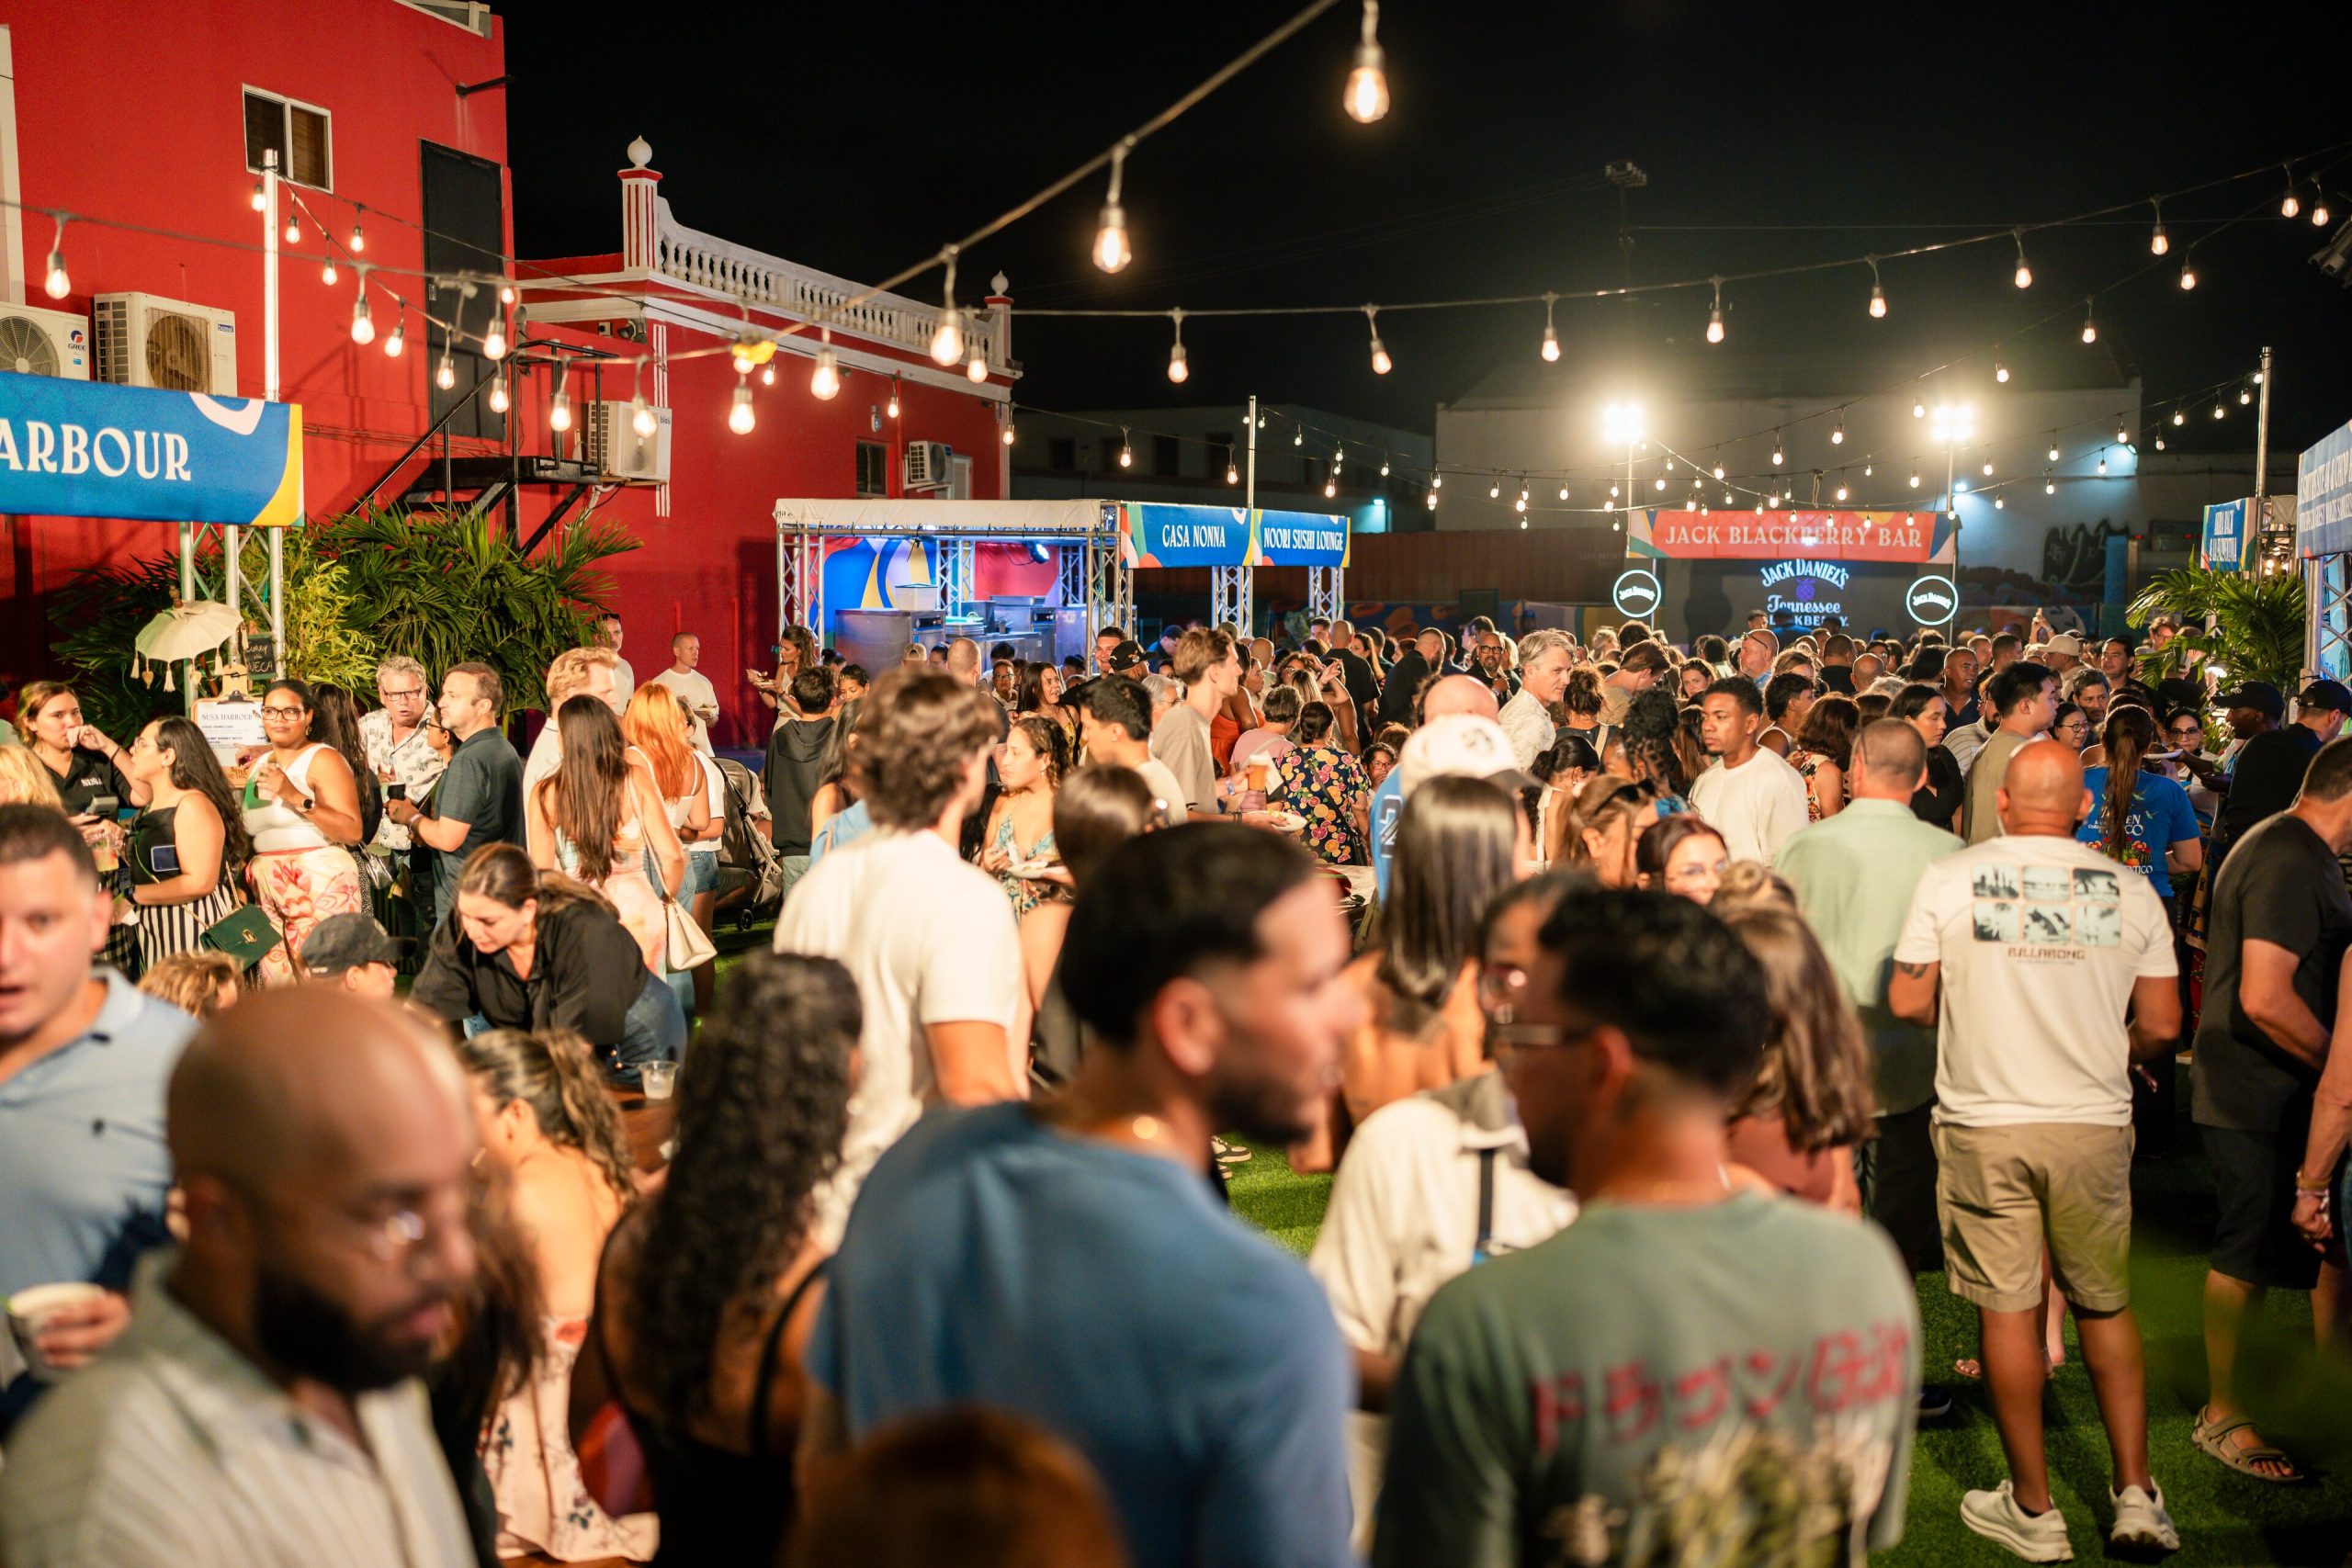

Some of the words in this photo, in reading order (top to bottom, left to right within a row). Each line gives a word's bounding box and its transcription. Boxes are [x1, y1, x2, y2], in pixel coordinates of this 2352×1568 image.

[0, 418, 191, 481] ARBOUR
[1162, 525, 1190, 547] CASA
[1193, 525, 1226, 547] NONNA
[1263, 527, 1290, 549] NOORI
[1292, 529, 1316, 550] SUSHI
[1317, 530, 1344, 551] LOUNGE
[1666, 526, 1720, 545] JACK
[1729, 526, 1869, 546] BLACKBERRY
[1878, 528, 1922, 547] BAR
[1760, 560, 1795, 587] JACK
[1796, 558, 1849, 590] DANIEL'S
